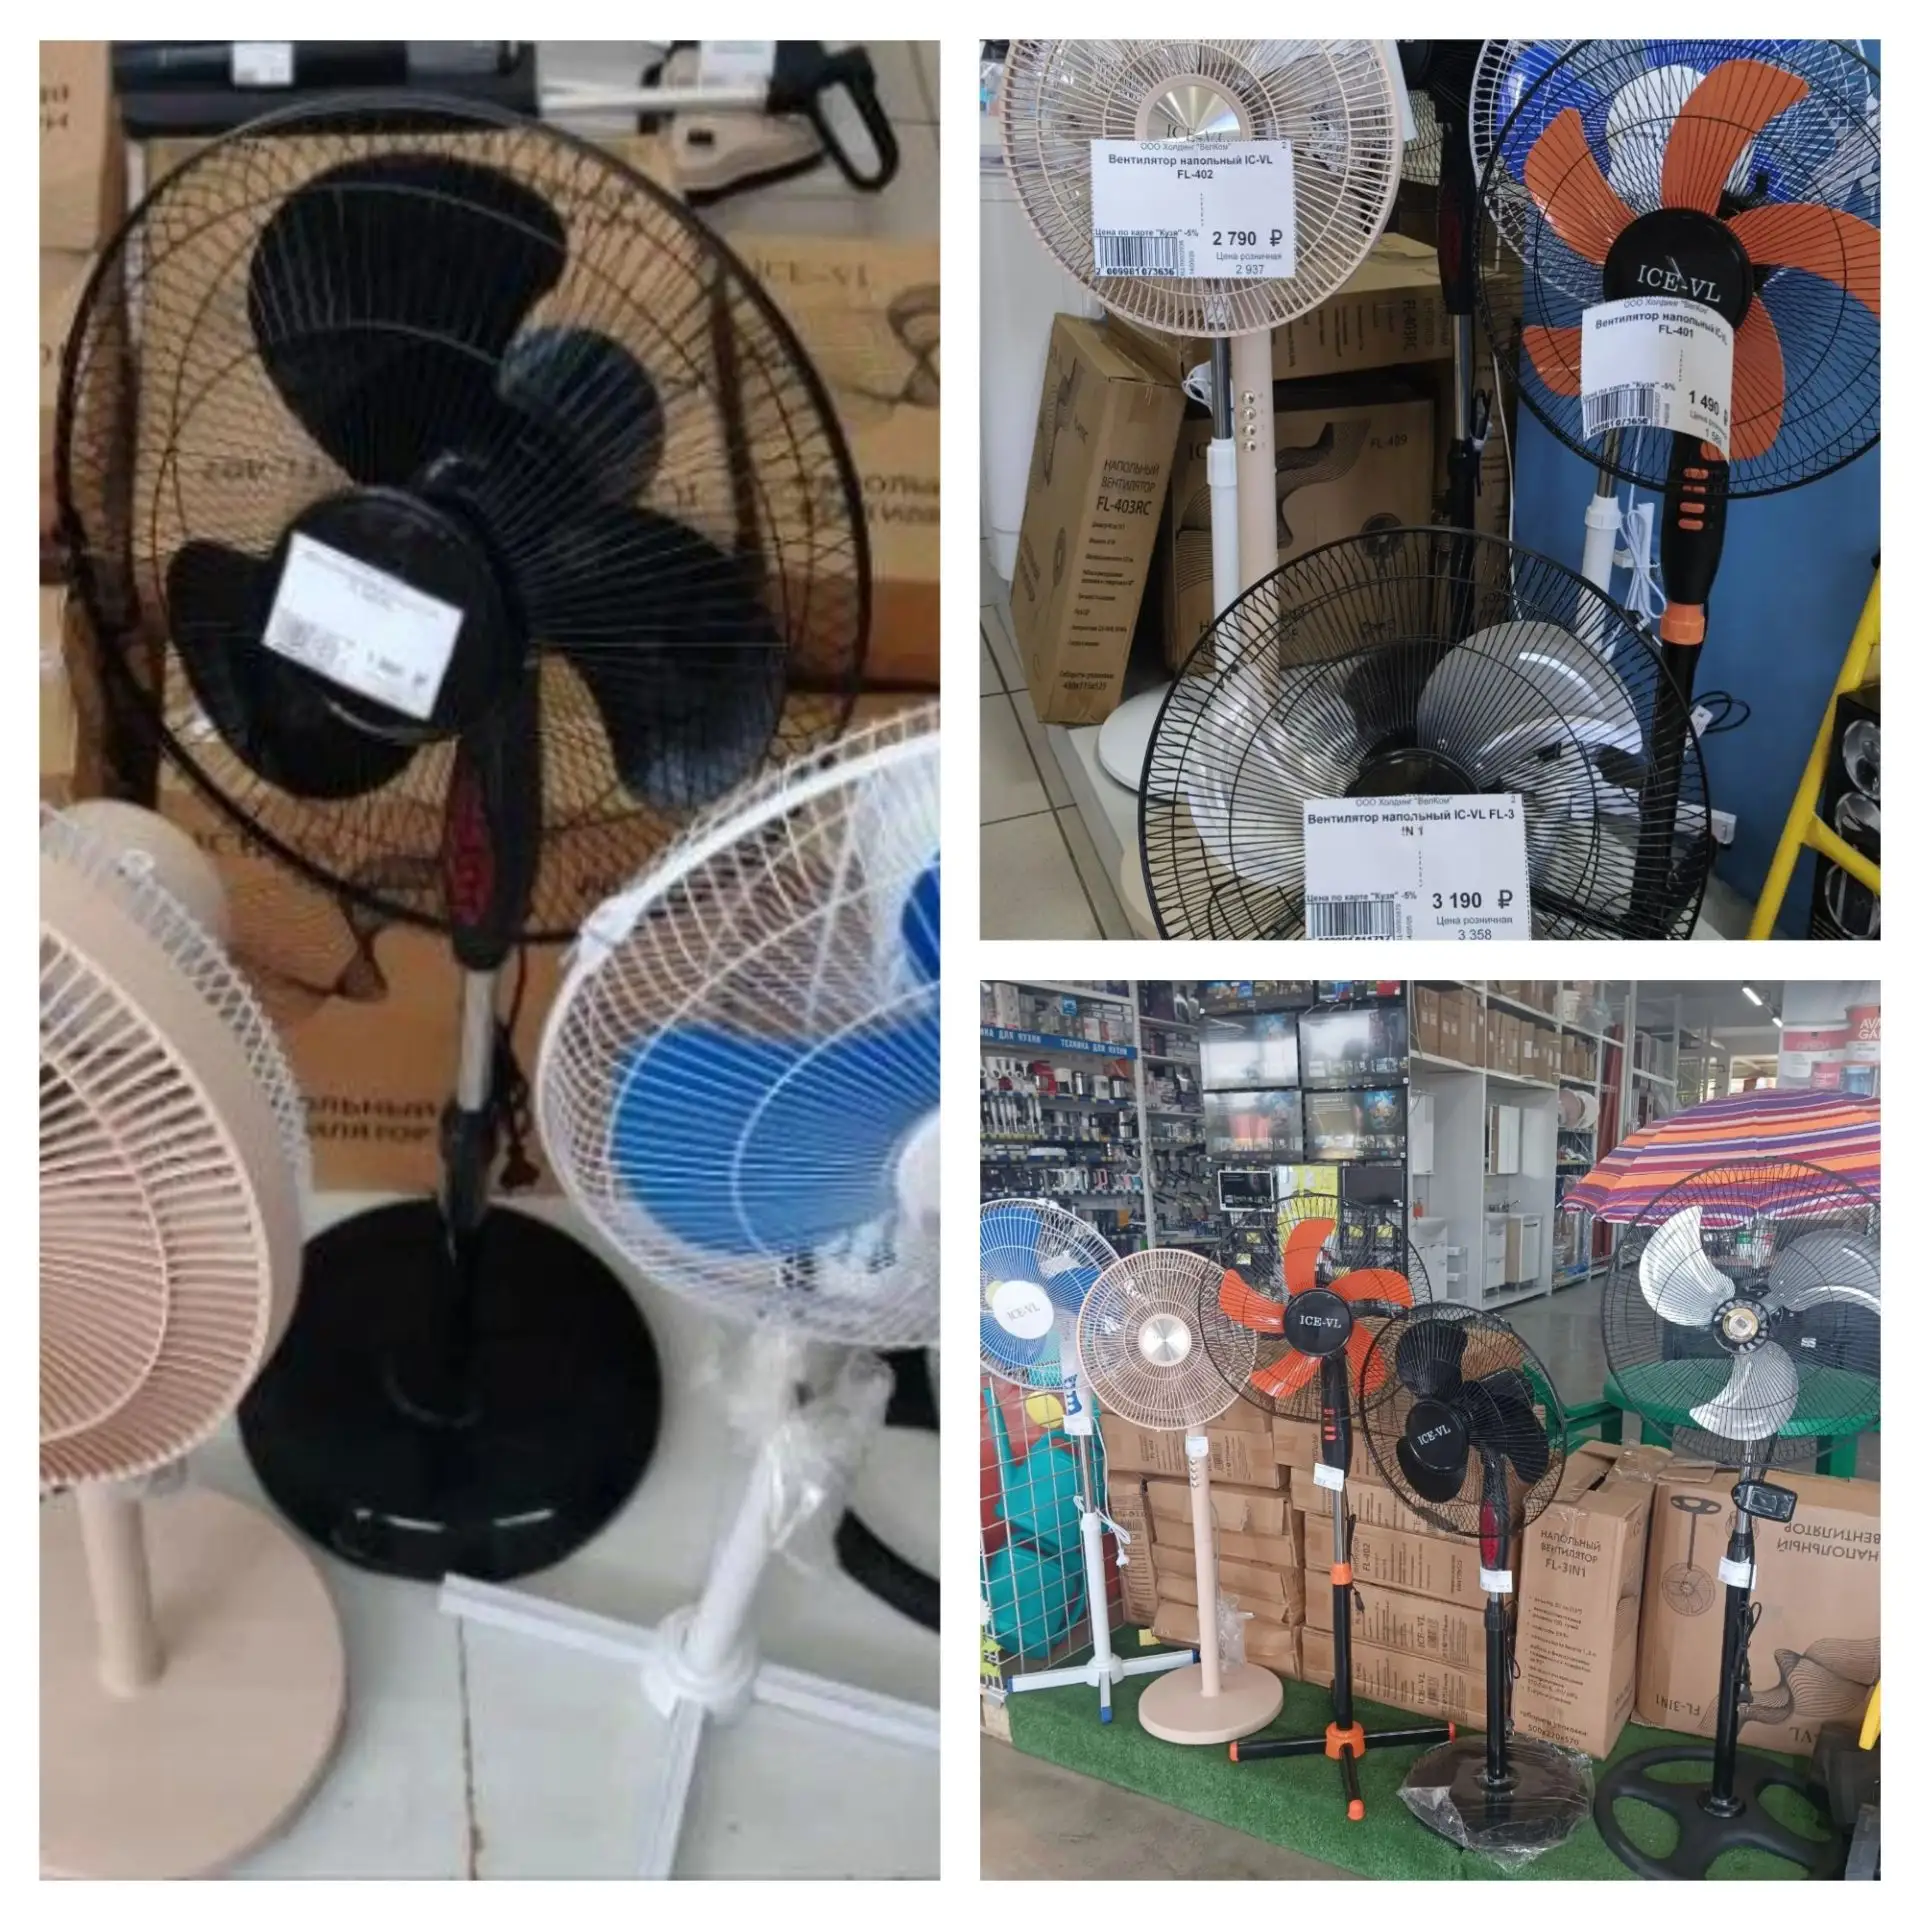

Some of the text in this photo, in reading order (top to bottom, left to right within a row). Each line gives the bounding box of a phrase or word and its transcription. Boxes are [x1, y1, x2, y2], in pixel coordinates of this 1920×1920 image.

[1163, 143, 1194, 152] Холдинг
[1108, 153, 1273, 167] Вентилятор напольный IC-VL
[1177, 169, 1214, 180] FL-402
[1095, 229, 1116, 238] Цена
[1212, 231, 1222, 246] 2
[1228, 231, 1257, 246] 790
[1216, 252, 1282, 262] Цена розничная
[1236, 264, 1265, 274] 2 937
[1637, 264, 1721, 302] ICE-VL
[1595, 311, 1659, 329] Вентилятор
[1658, 325, 1694, 338] FL-401
[1689, 390, 1696, 404] 1
[1700, 394, 1720, 416] 490
[1103, 459, 1160, 477] НАПОЛЬНЫЙ
[1101, 476, 1156, 493] ВЕНТИЛЯТОР
[1096, 496, 1152, 515] FL-403RC
[1355, 799, 1377, 807] ООО
[1378, 798, 1411, 807] Холдинг
[1308, 809, 1515, 825] Вентилятор напольный IC-VL FL-3
[1307, 894, 1329, 902] Цена
[1344, 893, 1369, 901] карте
[1401, 891, 1418, 900] -5%
[1432, 892, 1443, 909] 3
[1449, 892, 1482, 909] 190
[1436, 916, 1513, 926] Цена розничная
[1458, 929, 1492, 940] 3 358
[1006, 1302, 1041, 1321] ICE-VL
[1299, 1315, 1342, 1329] ICE-VL
[1417, 1424, 1451, 1446] ICE-VL
[1540, 1529, 1601, 1552] НАПОЛЬНЫЙ
[1784, 1522, 1881, 1545] ВЕНТИЛЯТОР
[1362, 1542, 1371, 1572] FL-402
[1541, 1542, 1598, 1564] ВЕНТИЛЯТОР
[1776, 1536, 1880, 1563] НАПОЛЬНЫЙ
[1545, 1558, 1586, 1578] FL-3IN1
[1655, 1693, 1701, 1716] FL-3IN1
